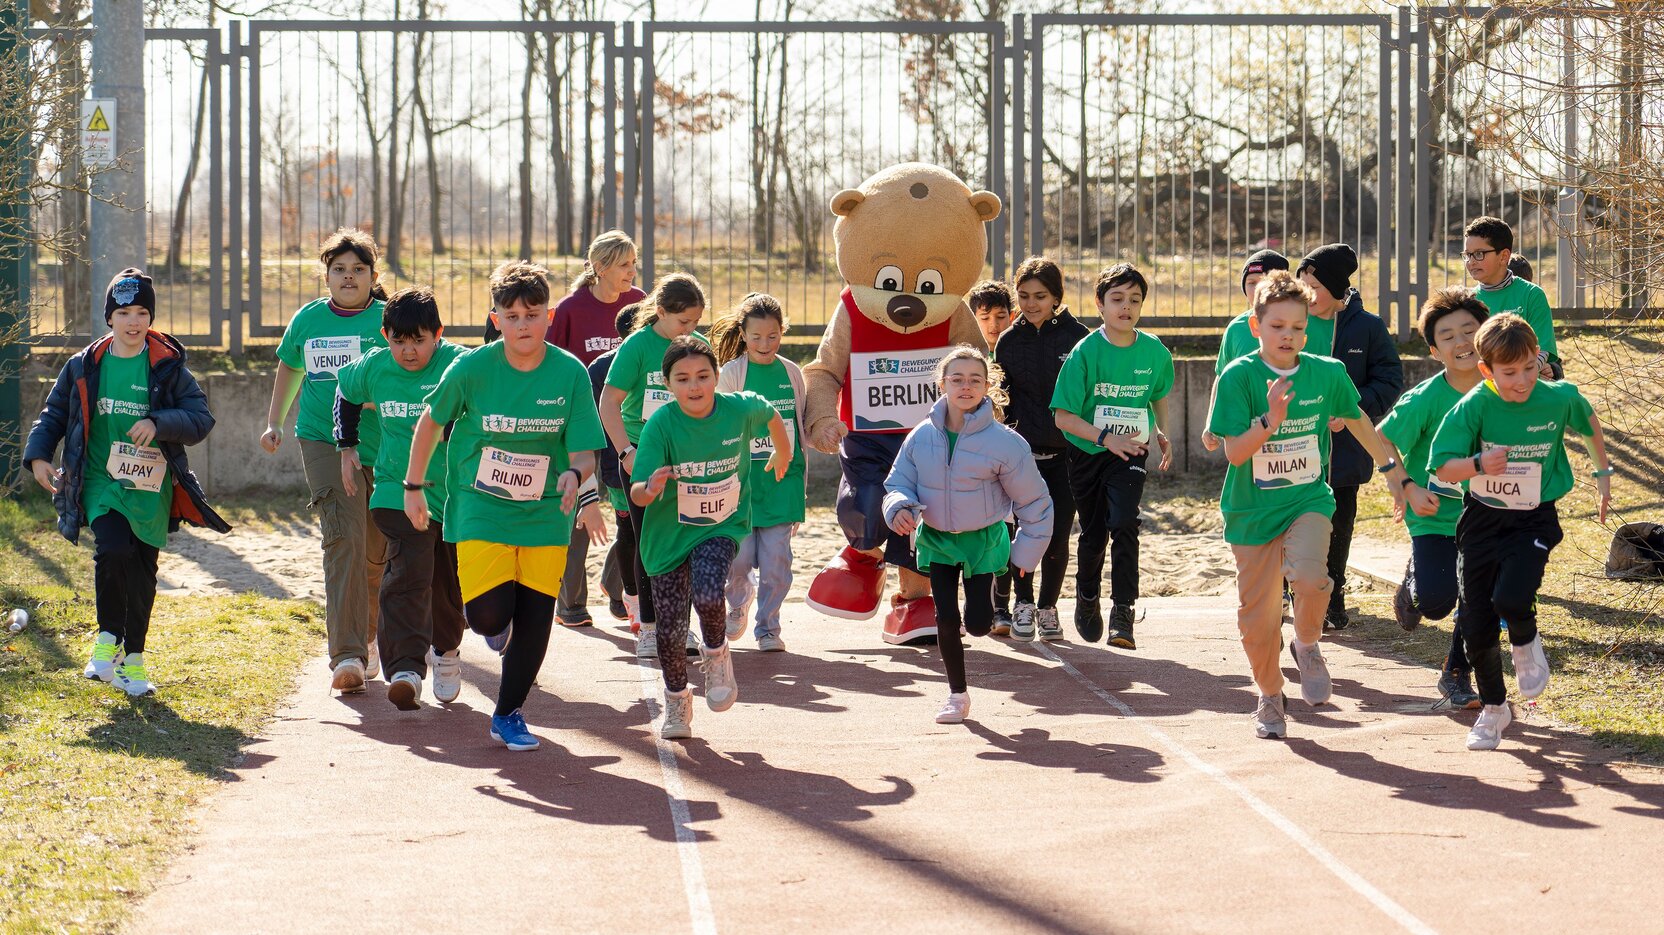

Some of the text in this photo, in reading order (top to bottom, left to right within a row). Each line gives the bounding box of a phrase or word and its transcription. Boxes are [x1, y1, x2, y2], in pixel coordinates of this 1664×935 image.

[313, 354, 352, 369] VENURI
[536, 398, 557, 406] degewo
[868, 381, 942, 408] BERLIN
[516, 425, 560, 433] CHALLENGE
[517, 417, 565, 426] BEWEGUNGS
[1280, 421, 1317, 434] CHALLENGE
[1526, 424, 1548, 433] degewo
[118, 462, 154, 478] ALPAY
[1267, 457, 1307, 475] MILAN
[491, 468, 533, 487] RILIND
[1486, 480, 1521, 496] LUCA
[700, 498, 725, 515] ELIF
